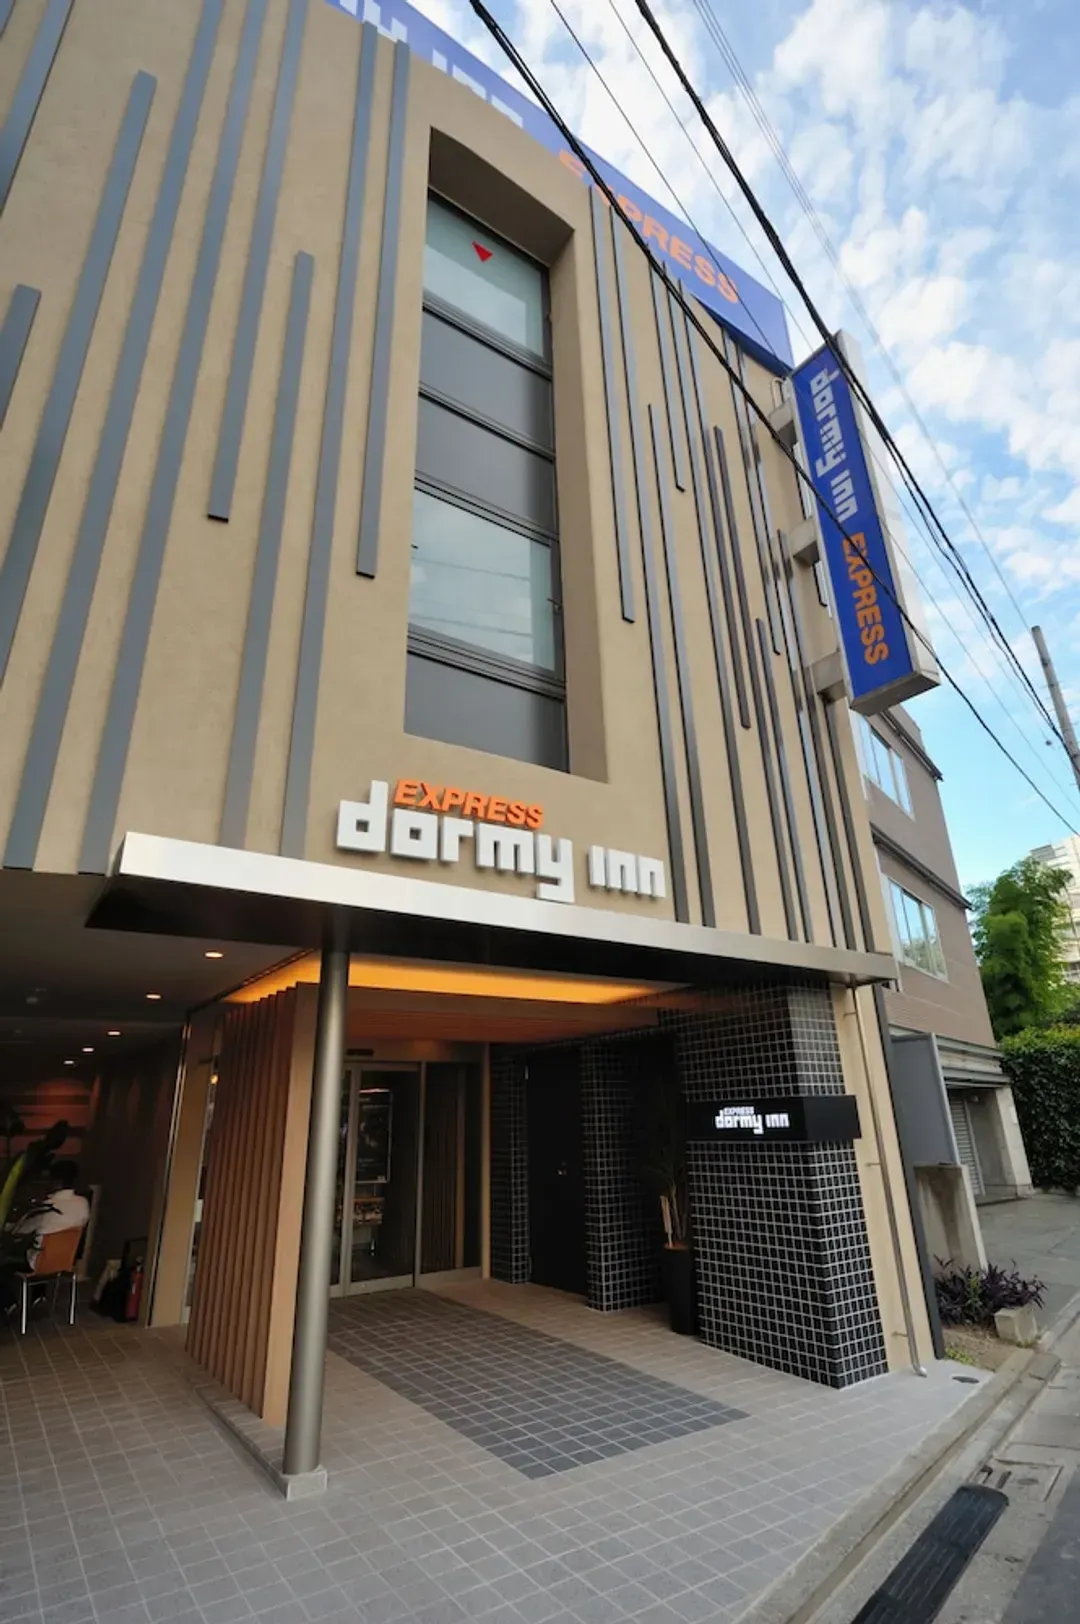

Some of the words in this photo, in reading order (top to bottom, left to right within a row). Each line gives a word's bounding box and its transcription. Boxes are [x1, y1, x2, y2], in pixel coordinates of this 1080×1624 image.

[810, 368, 847, 478] dormy
[830, 469, 858, 523] inn
[336, 780, 575, 903] dormy
[588, 845, 666, 898] inn
[393, 778, 544, 830] EXPRESS
[715, 1109, 764, 1135] dormy
[765, 1113, 790, 1128] inn
